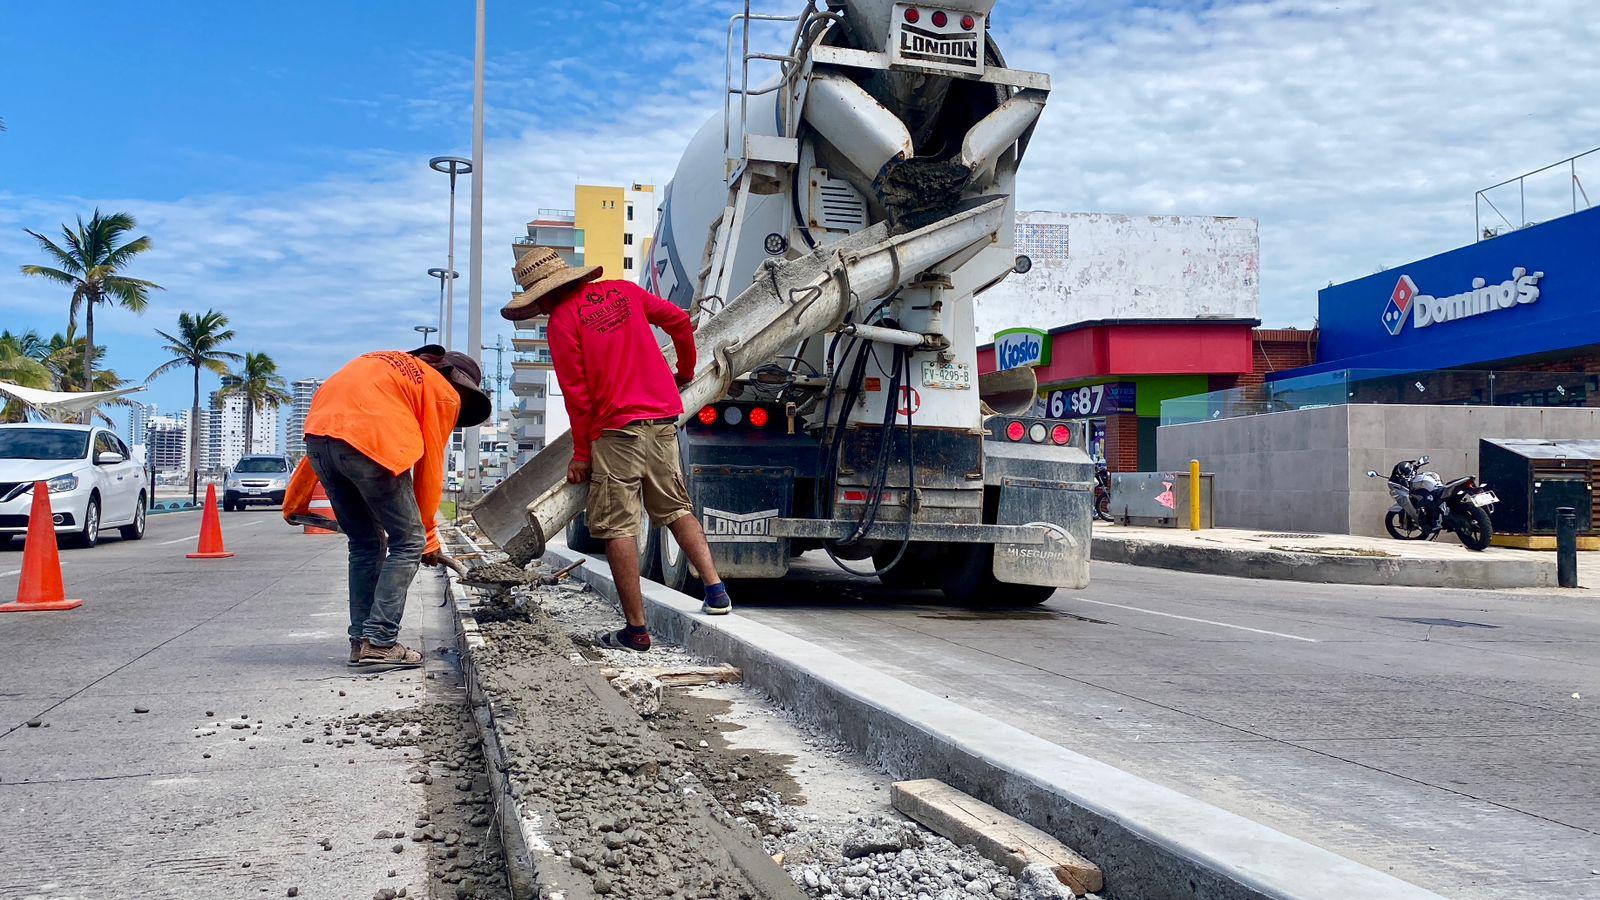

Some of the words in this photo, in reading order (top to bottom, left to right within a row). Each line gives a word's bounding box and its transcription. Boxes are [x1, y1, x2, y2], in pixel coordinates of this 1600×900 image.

[901, 31, 978, 59] LONDON
[1413, 266, 1544, 329] Domino's
[999, 335, 1040, 371] Kiosko
[924, 368, 969, 382] FV-4295-B
[703, 515, 769, 535] LONDO
